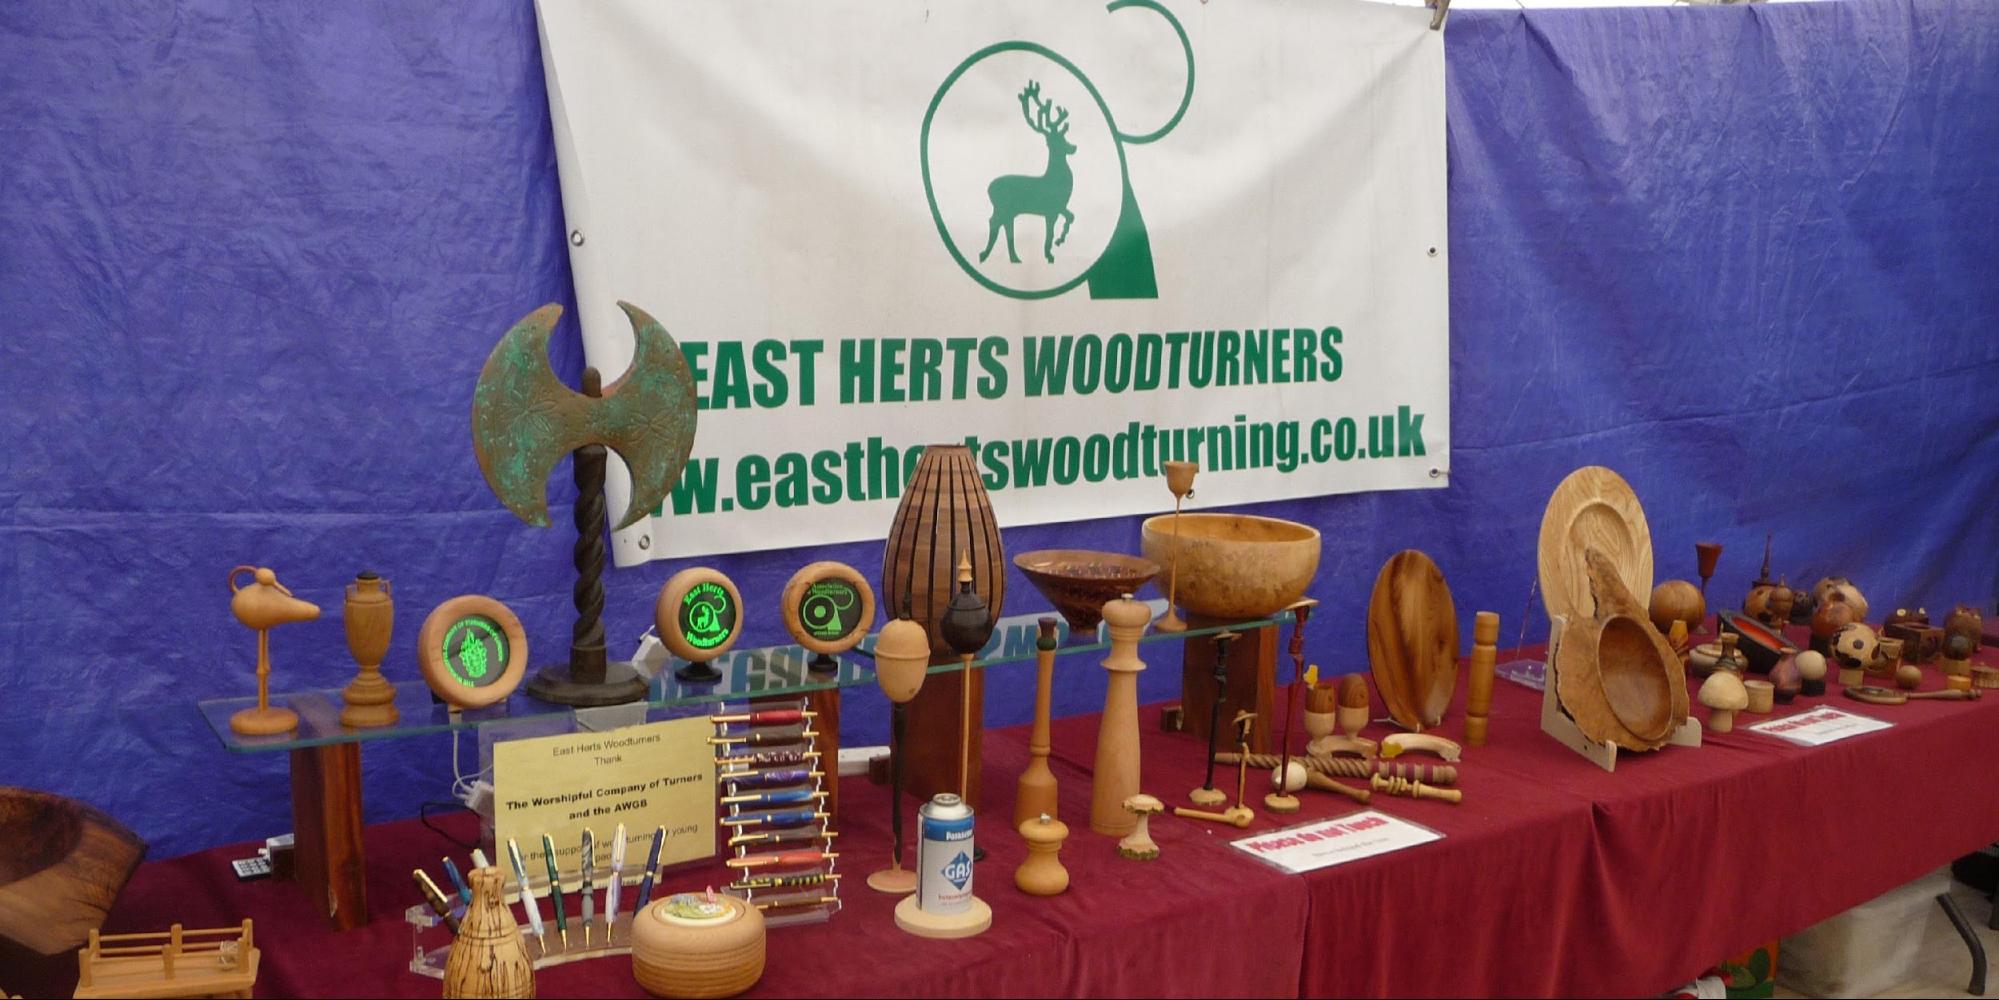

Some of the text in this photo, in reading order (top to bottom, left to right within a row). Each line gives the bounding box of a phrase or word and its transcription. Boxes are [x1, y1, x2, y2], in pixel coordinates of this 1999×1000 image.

[680, 326, 1344, 410] EAST HERTS WOODTURNERS
[651, 405, 1427, 517] w.easthswoodturning.co.uk
[552, 733, 661, 757] East Herts Woodturners
[594, 753, 622, 766] Thank
[506, 772, 703, 811] The Worshipful Company of Turners
[569, 798, 648, 820] and the AWGB
[672, 823, 698, 836] young
[945, 860, 971, 879] GAS
